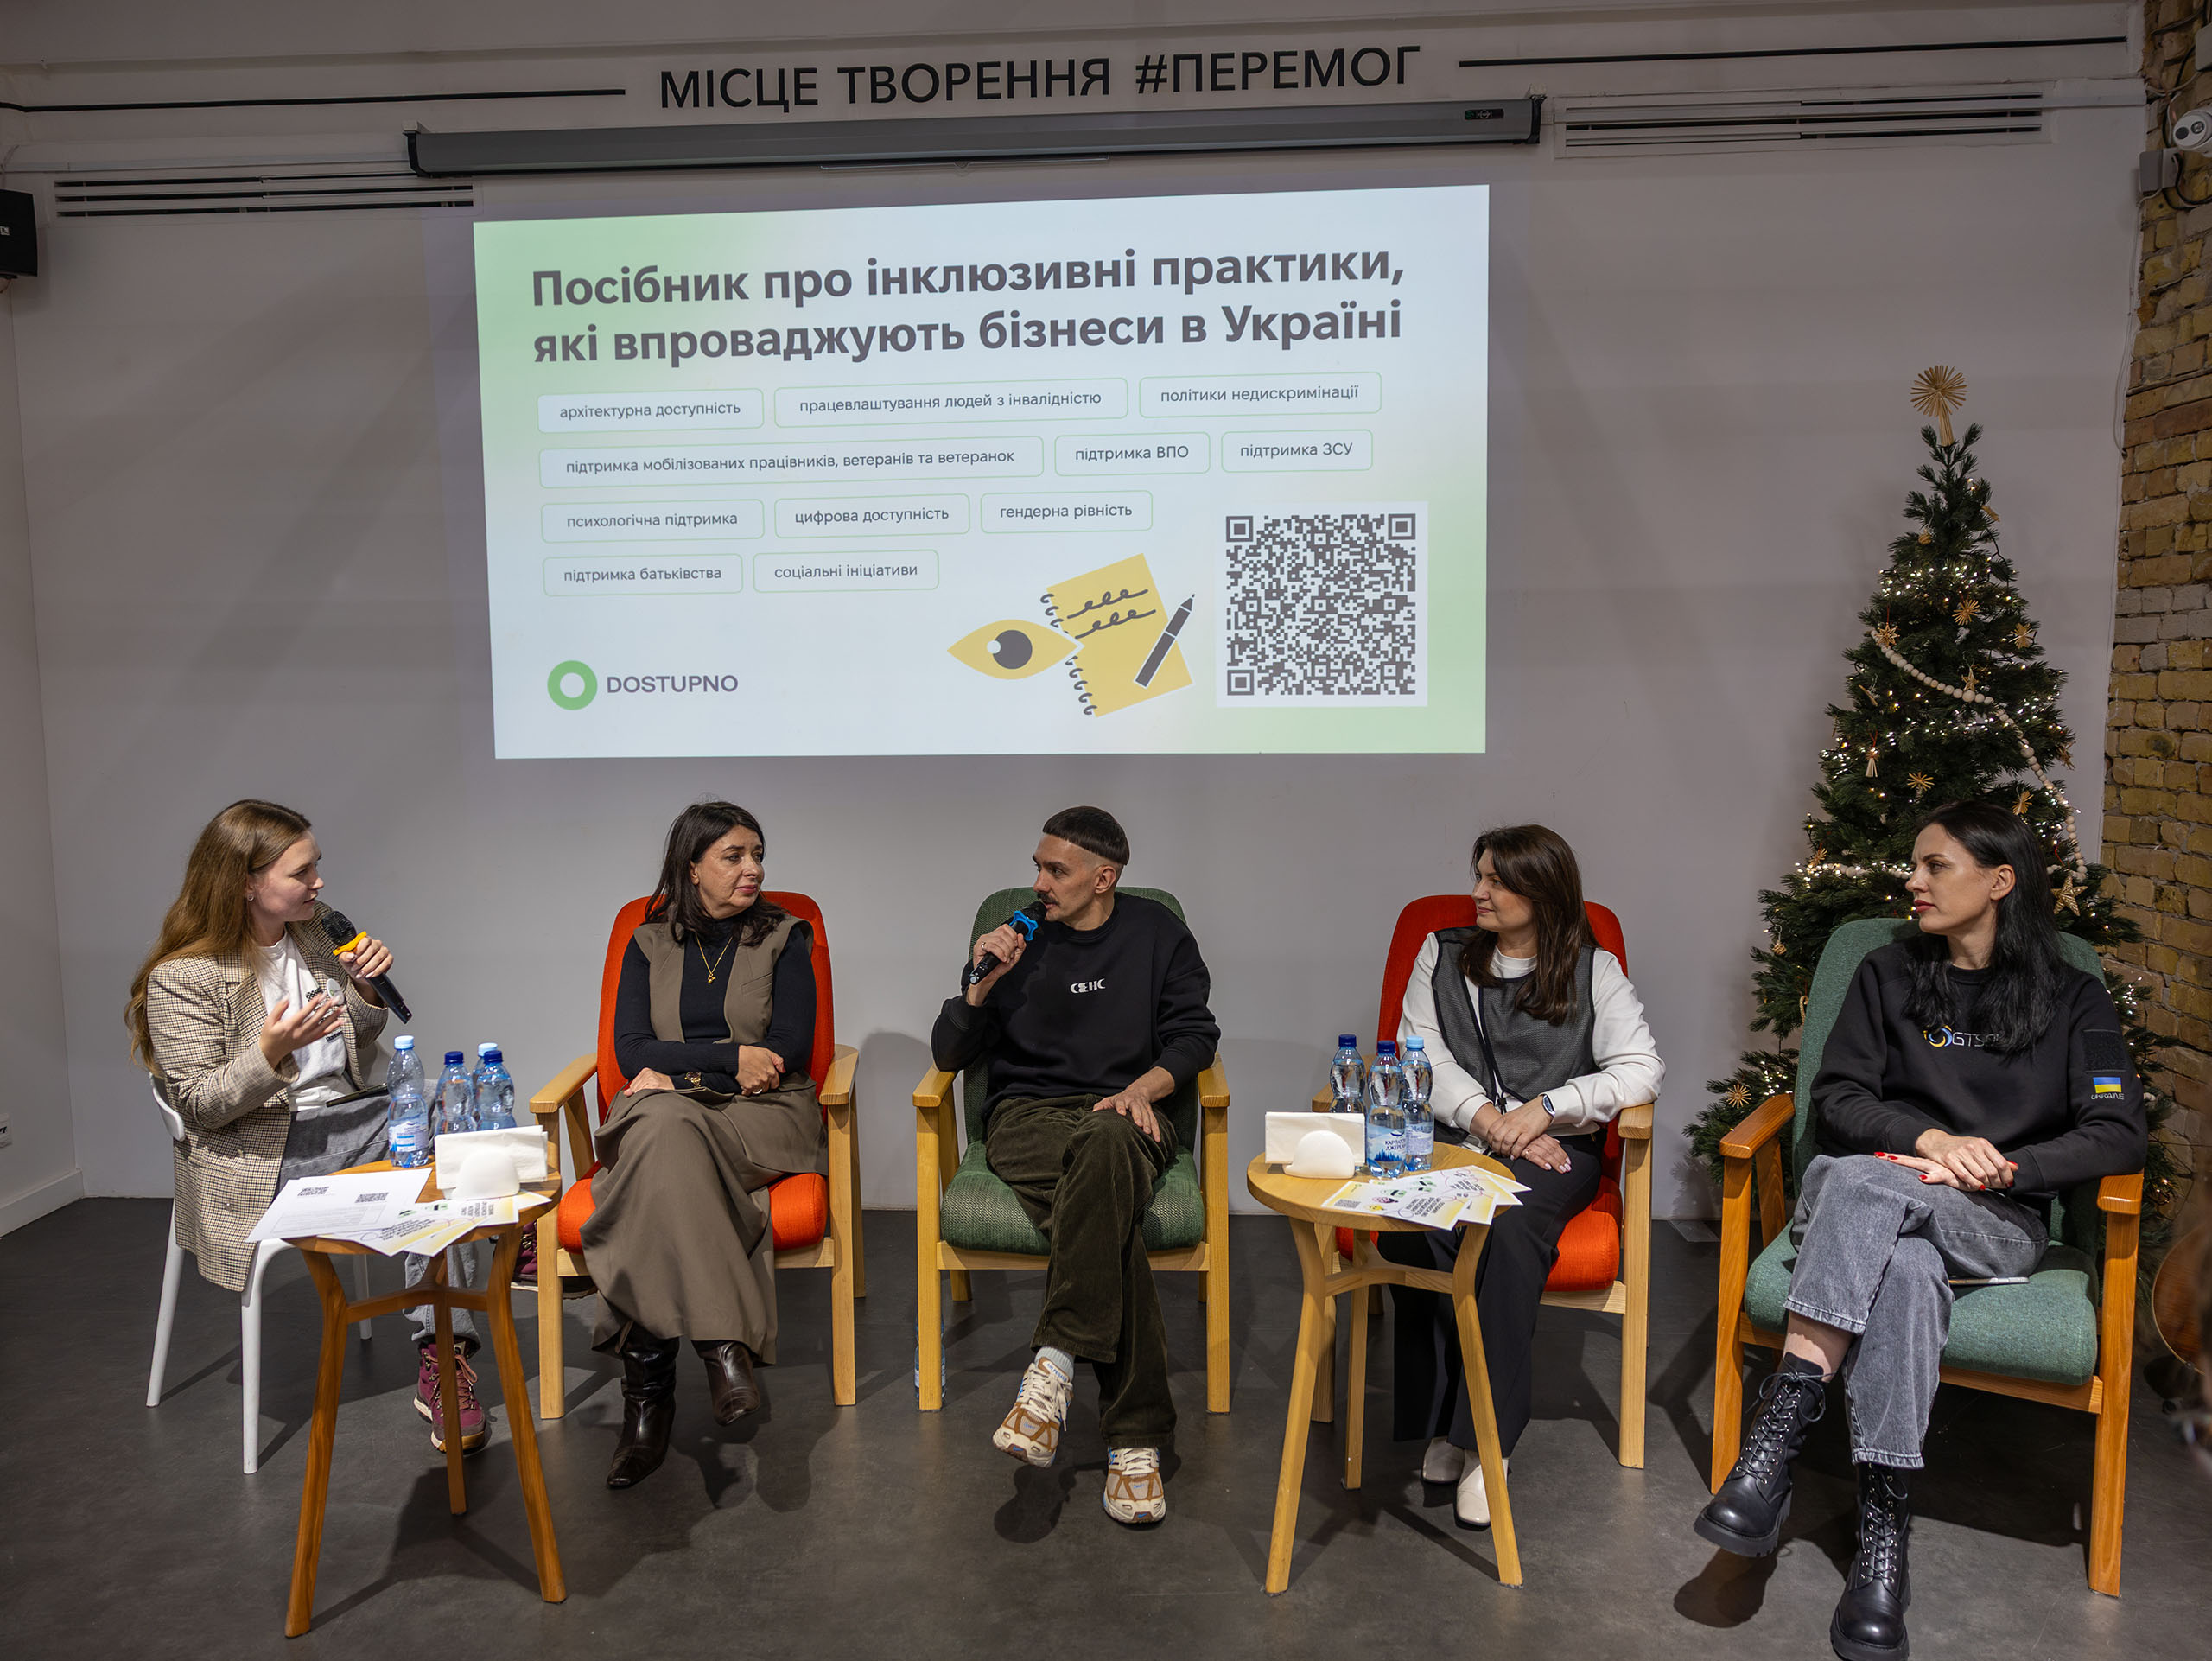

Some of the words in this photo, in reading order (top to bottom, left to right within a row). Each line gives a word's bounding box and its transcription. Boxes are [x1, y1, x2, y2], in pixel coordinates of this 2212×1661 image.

[660, 67, 819, 114] МІСЦЕ
[836, 57, 1109, 105] ТВОРЕННЯ
[1135, 45, 1421, 95] #ПЕРЕМОГ
[532, 264, 750, 307] Посібник
[764, 269, 853, 309] про
[867, 248, 1135, 296] інклюзивні
[1153, 251, 1404, 296] практики,
[533, 323, 598, 363] які
[613, 322, 965, 368] впроваджують
[979, 309, 1164, 349] бізнеси
[1181, 315, 1207, 343] в
[1220, 298, 1402, 351] Україні
[1160, 388, 1227, 402] політики
[1231, 385, 1359, 402] недискримінації
[559, 405, 652, 421] архітектурна
[655, 401, 741, 418] доступність
[799, 398, 940, 415] працевлаштування
[944, 393, 992, 409] людей
[996, 396, 1005, 406] з
[1008, 391, 1102, 407] інвалідністю
[1075, 447, 1152, 463] підтримка
[1156, 445, 1189, 459] ВПО
[1240, 443, 1318, 460] підтримка
[1322, 442, 1353, 455] ЗСУ
[566, 460, 639, 475] підтримка
[643, 457, 746, 471] мобілізованих
[749, 454, 839, 471] працівників,
[842, 452, 914, 468] ветеранів
[917, 454, 933, 464] та
[938, 452, 1015, 466] ветеранок
[567, 513, 661, 528] психологічна
[664, 512, 738, 528] підтримка
[795, 510, 859, 525] цифрова
[862, 507, 950, 524] доступність
[1000, 506, 1069, 520] гендерна
[1073, 503, 1133, 519] рівність
[563, 569, 636, 584] підтримка
[639, 567, 721, 581] батьківства
[774, 564, 842, 580] соціальні
[846, 563, 918, 578] ініціативи
[607, 674, 739, 694] DOSTUPNO
